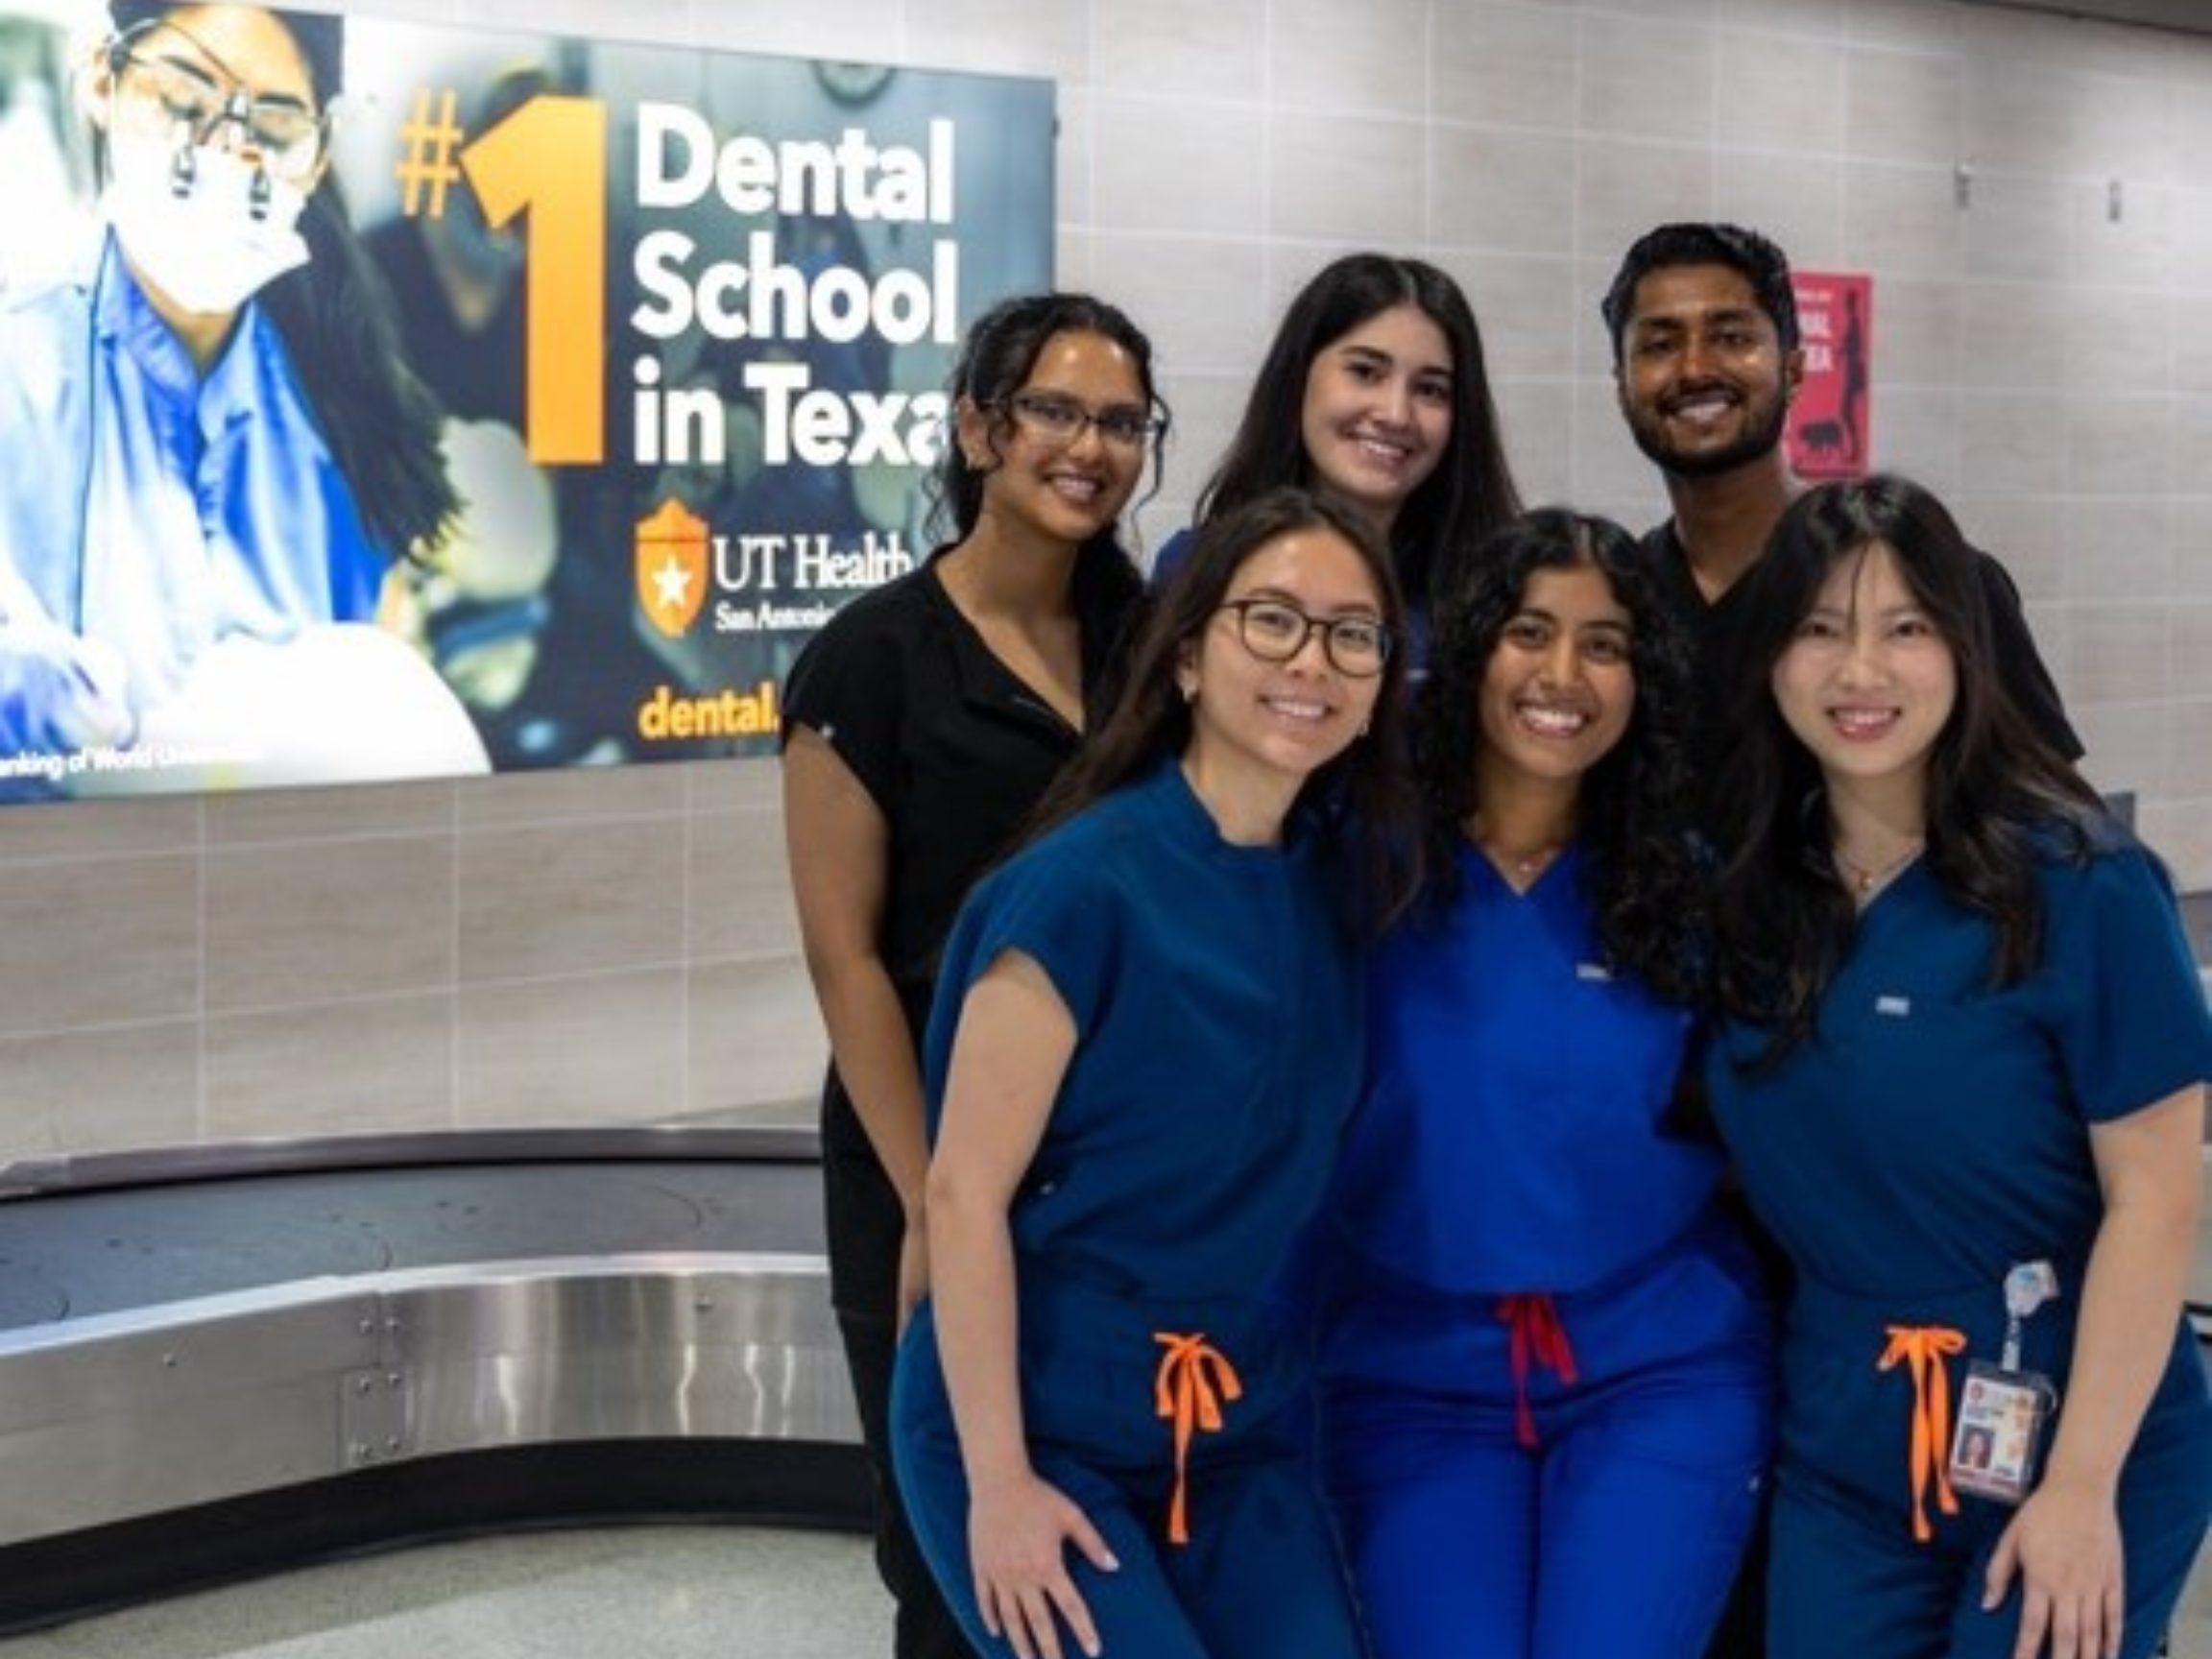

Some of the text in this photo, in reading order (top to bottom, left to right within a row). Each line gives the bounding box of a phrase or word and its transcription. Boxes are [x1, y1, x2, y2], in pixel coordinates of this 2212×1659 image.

[637, 102, 954, 224] Dental
[396, 89, 607, 465] #1
[630, 230, 957, 344] School
[634, 355, 948, 466] in Texa
[712, 530, 914, 591] UT Health
[714, 600, 756, 632] San
